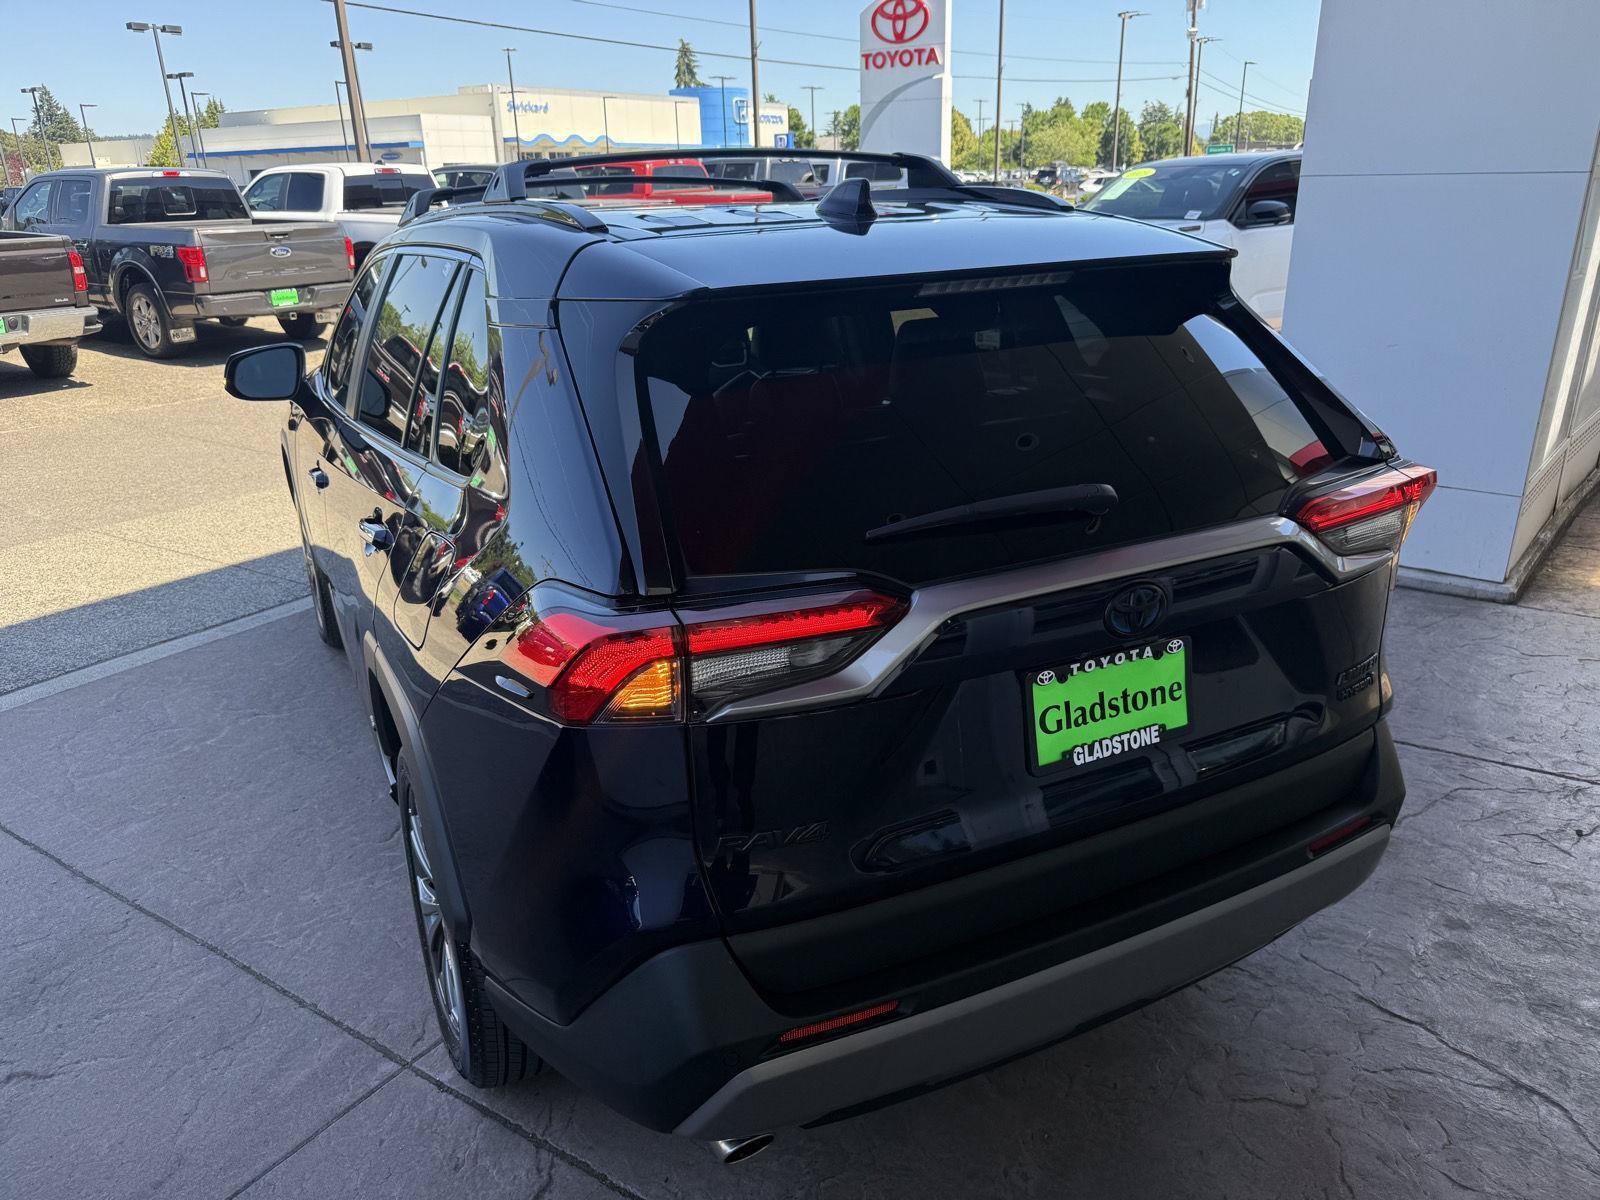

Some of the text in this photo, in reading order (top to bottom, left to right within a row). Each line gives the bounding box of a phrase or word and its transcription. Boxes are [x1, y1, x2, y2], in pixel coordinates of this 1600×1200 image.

[861, 47, 943, 70] TOYOTA
[1069, 645, 1154, 676] TOYOTA
[1038, 680, 1184, 735] Gladstone
[1072, 723, 1161, 767] GLADSTONE
